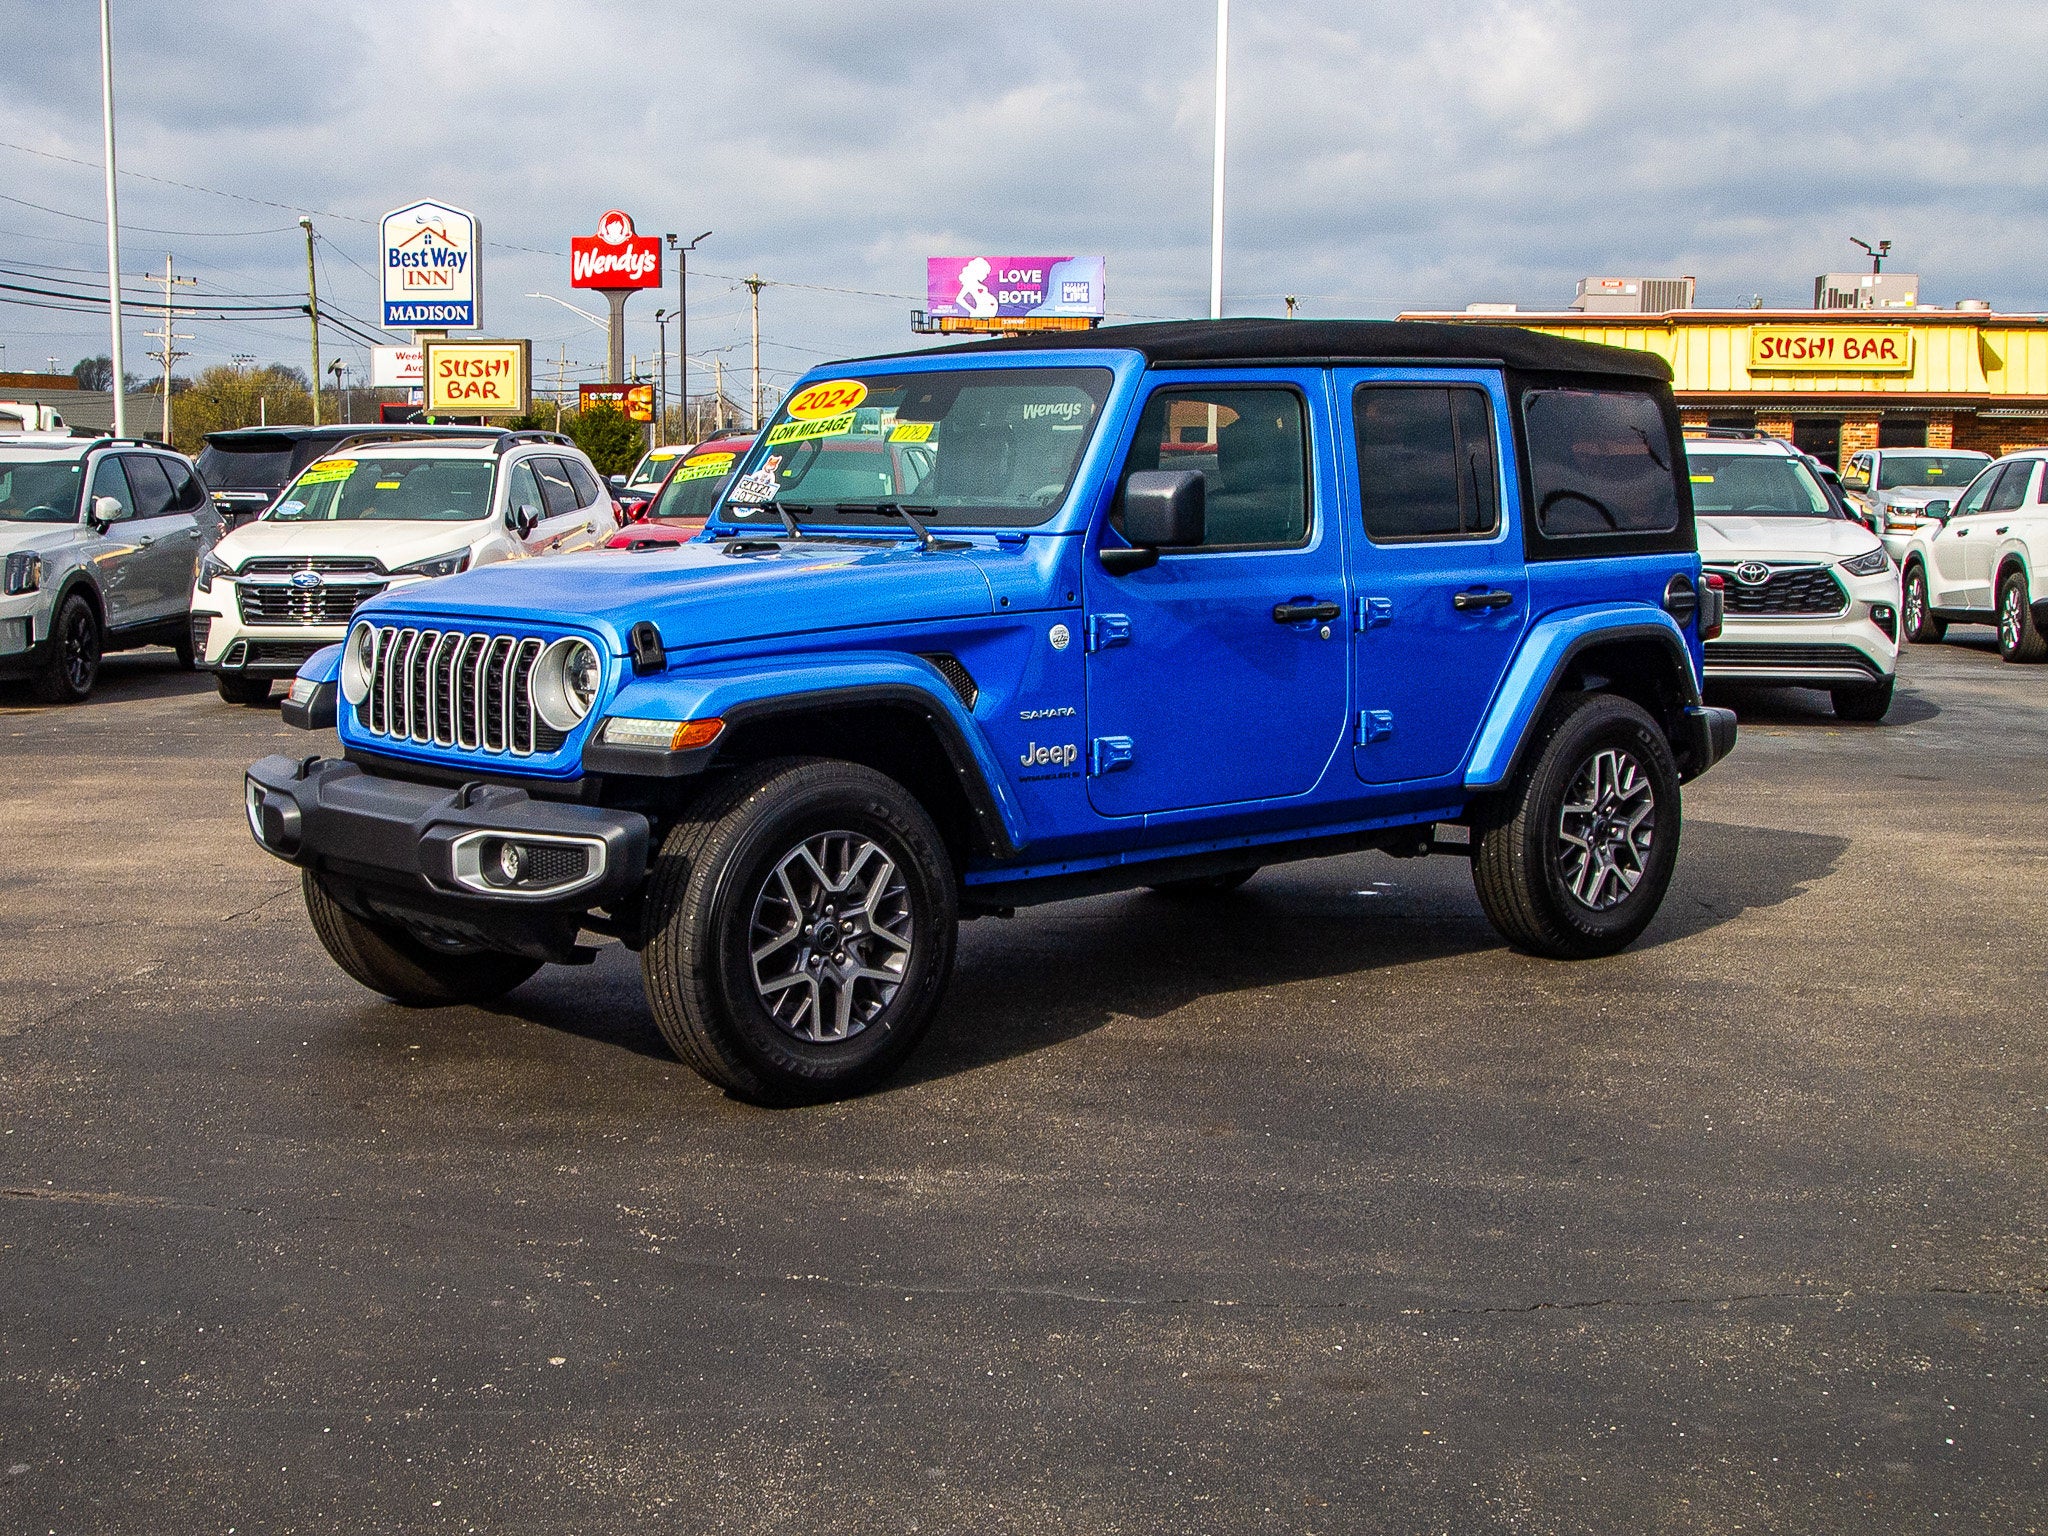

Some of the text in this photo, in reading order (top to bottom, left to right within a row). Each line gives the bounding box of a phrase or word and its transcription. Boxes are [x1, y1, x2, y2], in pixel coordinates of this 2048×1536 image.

[388, 247, 467, 273] Best Way
[573, 243, 656, 281] Wendy's
[408, 270, 448, 285] INN
[999, 269, 1042, 283] LOVE
[999, 290, 1042, 304] BOTH
[388, 305, 469, 321] MADISON
[1760, 337, 1899, 360] SUSHI BAR
[439, 359, 509, 378] SUSHI
[447, 381, 500, 399] BAR
[794, 388, 861, 411] 2024
[769, 416, 852, 442] LOW MILEAGE
[1020, 707, 1076, 720] SAHARA
[1020, 742, 1077, 767] Jeep
